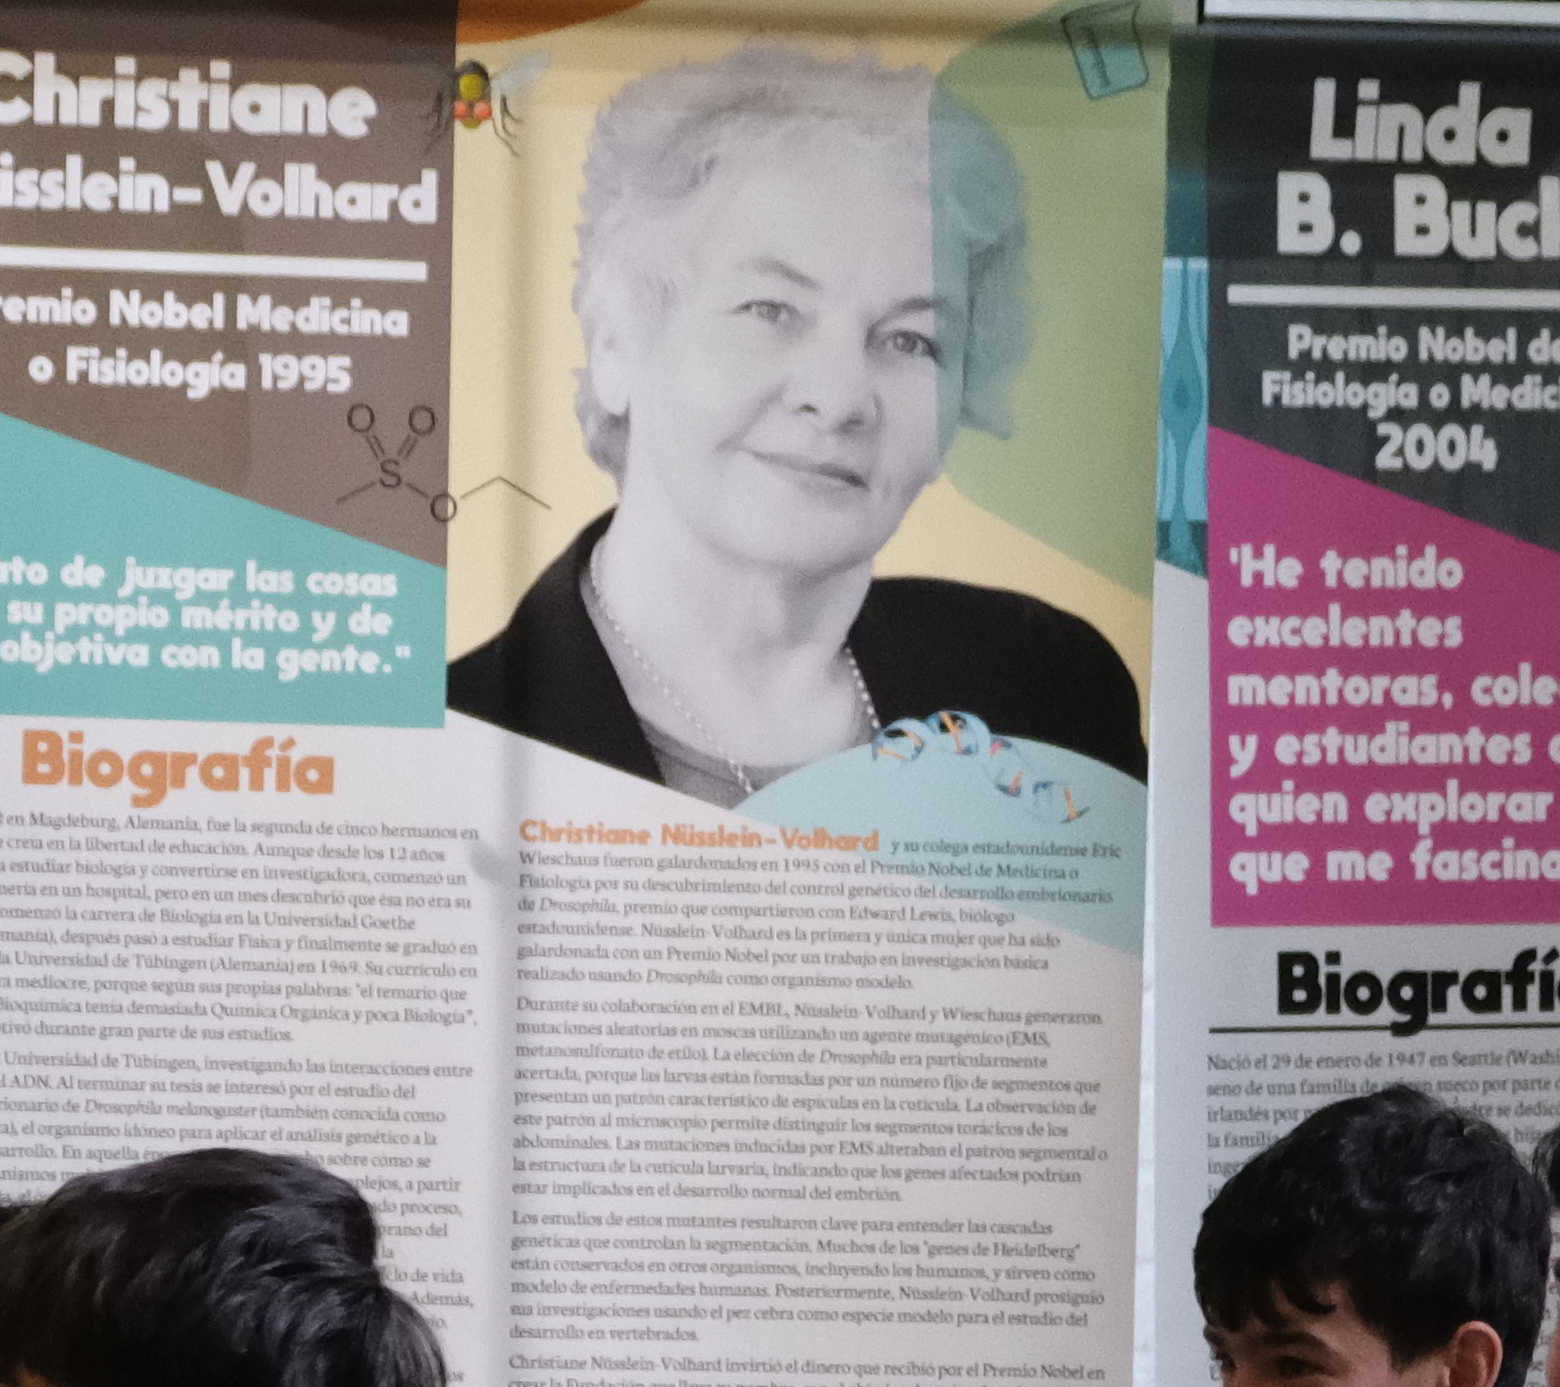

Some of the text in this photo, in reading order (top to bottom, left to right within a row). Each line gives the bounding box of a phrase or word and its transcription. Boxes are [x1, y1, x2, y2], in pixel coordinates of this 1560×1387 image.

[1310, 78, 1532, 166] Linda
[1277, 171, 1361, 256] B.
[109, 289, 225, 330] Nobel
[237, 294, 409, 337] Medicina
[1288, 323, 1408, 362] Premio
[1418, 326, 1517, 363] Nobel
[28, 346, 352, 400] o Fisiología 1995
[1262, 370, 1419, 419] Fisiología
[1429, 383, 1450, 409] o
[1375, 422, 1498, 471] 2004
[60, 555, 106, 588] de
[246, 559, 295, 594] las
[306, 571, 398, 597] cosas
[1320, 544, 1463, 589] tenido
[7, 600, 44, 625] su
[50, 596, 170, 635] propio
[181, 596, 300, 629] mérito
[312, 610, 337, 643] y
[348, 602, 393, 636] de
[1227, 602, 1463, 648] excelentes
[0, 632, 151, 673] objetiva
[161, 644, 221, 669] con
[232, 637, 265, 670] la
[276, 642, 411, 681] gente."
[1227, 667, 1453, 709] mentoras,
[22, 729, 335, 809] Biografía
[1229, 734, 1258, 778] y
[1274, 720, 1532, 766] estudiantes
[1229, 779, 1348, 837] quien
[1364, 778, 1554, 835] explorar
[519, 818, 880, 852] Christiane Nüsslein-Volhard
[1229, 851, 1310, 896] que
[1326, 850, 1393, 881] me
